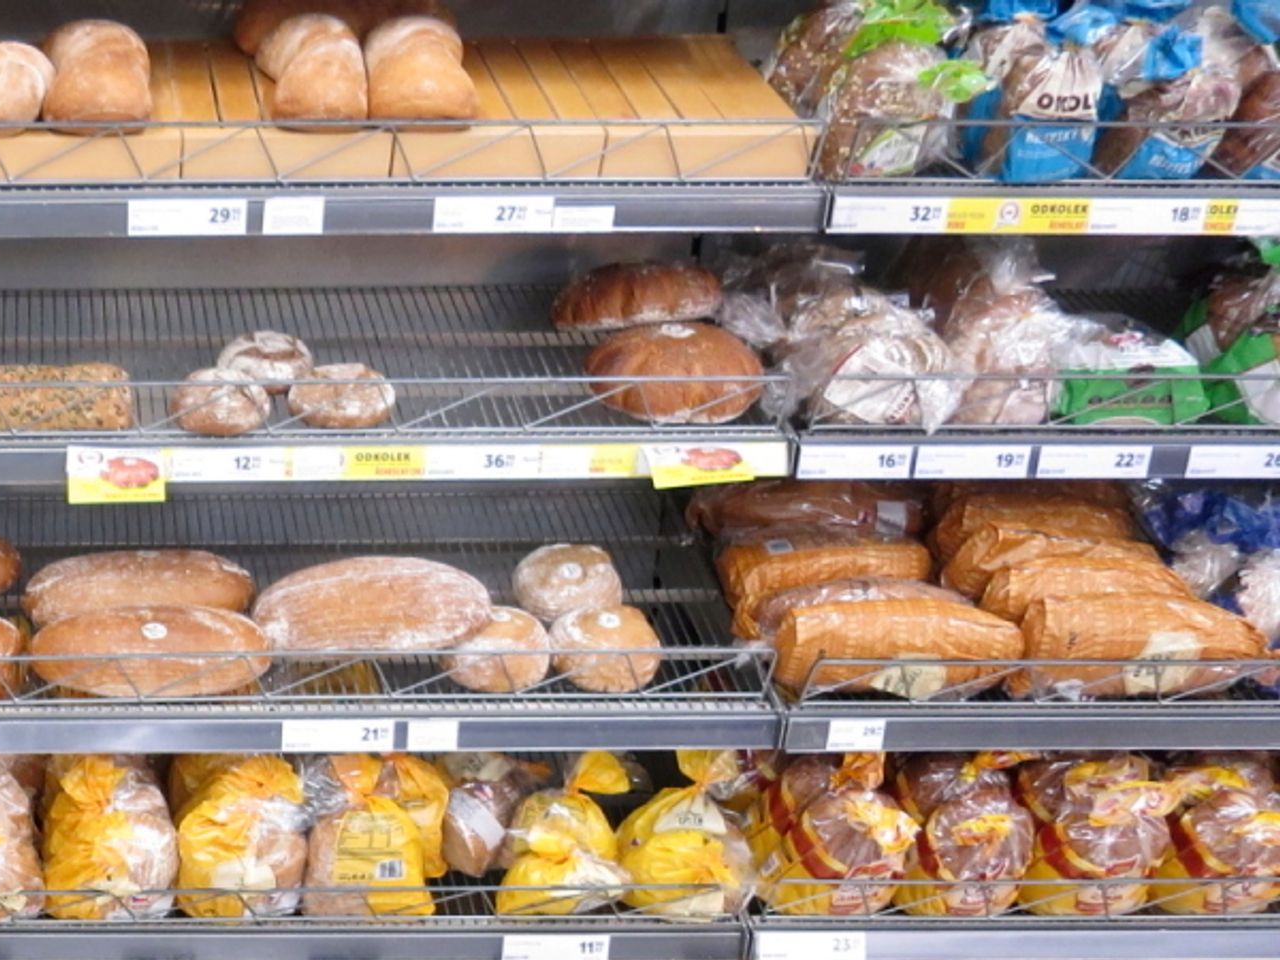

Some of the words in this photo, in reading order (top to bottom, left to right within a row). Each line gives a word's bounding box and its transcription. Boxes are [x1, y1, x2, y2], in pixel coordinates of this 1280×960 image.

[209, 208, 230, 223] 29
[496, 206, 516, 221] 27
[910, 206, 931, 221] 32
[1172, 207, 1190, 221] 18
[234, 457, 251, 470] 12
[355, 453, 411, 462] ODKOLEK
[484, 454, 504, 468] 36
[878, 454, 895, 468] 16
[996, 454, 1013, 468] 19
[1115, 454, 1134, 468] 22
[362, 727, 379, 741] 21
[580, 941, 594, 953] 11
[833, 938, 851, 951] 23
